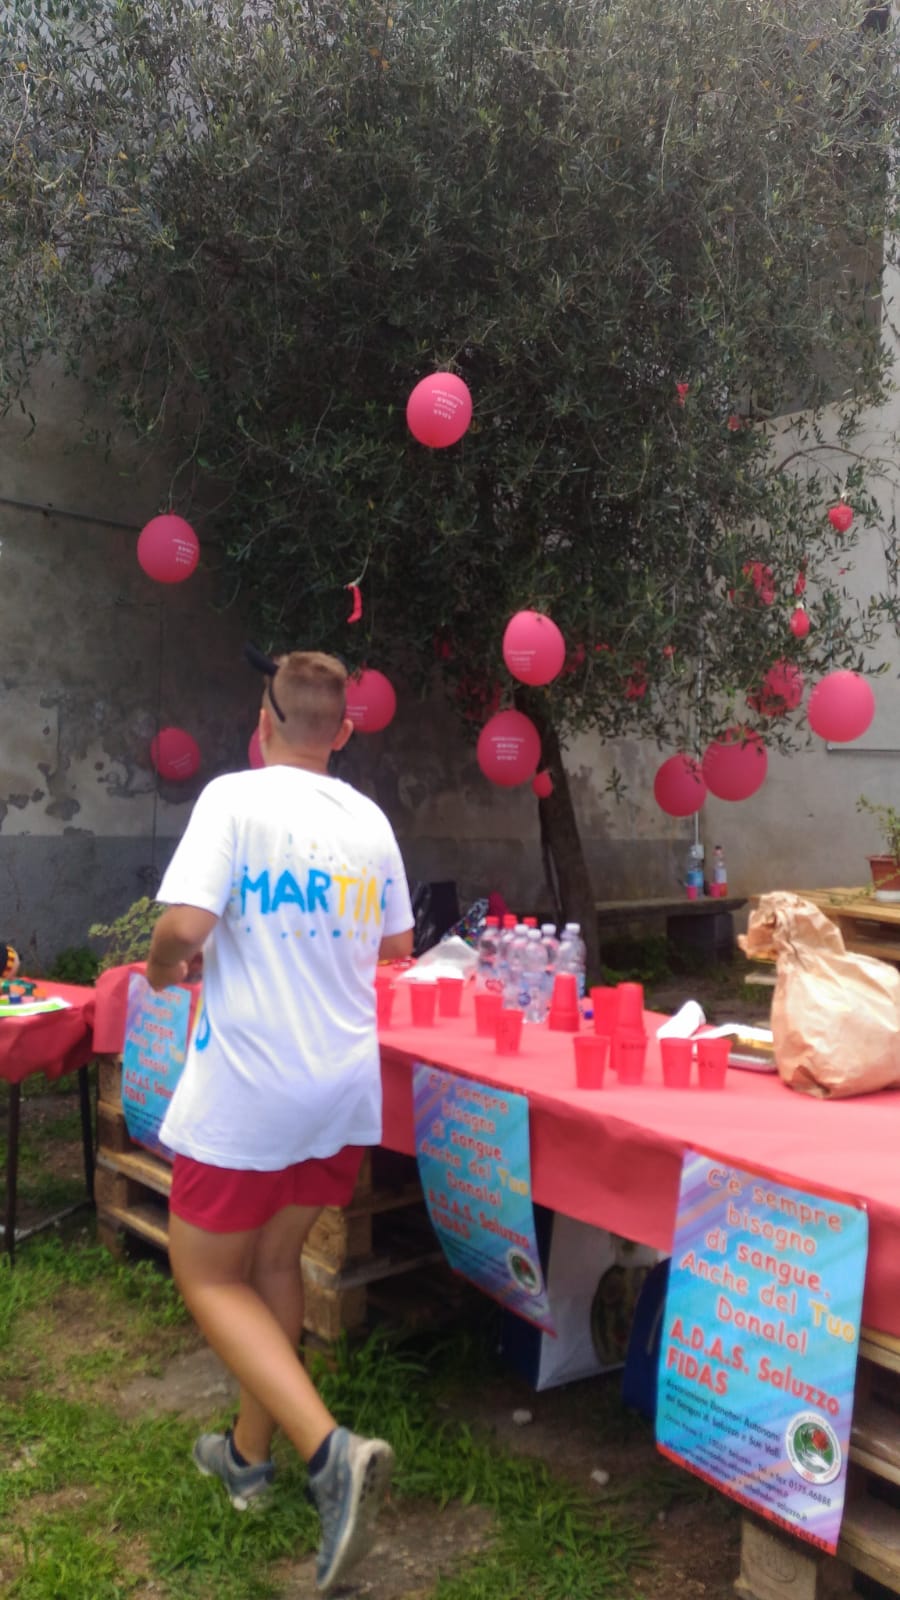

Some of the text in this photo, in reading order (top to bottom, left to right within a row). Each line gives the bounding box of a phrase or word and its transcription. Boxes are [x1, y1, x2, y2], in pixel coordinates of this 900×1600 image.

[727, 1200, 817, 1256] bisogno
[752, 1186, 842, 1233] sempre
[705, 1227, 727, 1255] di
[680, 1252, 856, 1343] Anche del Tuo
[666, 1346, 729, 1396] FIDAS
[757, 1356, 841, 1417] Saluzzo
